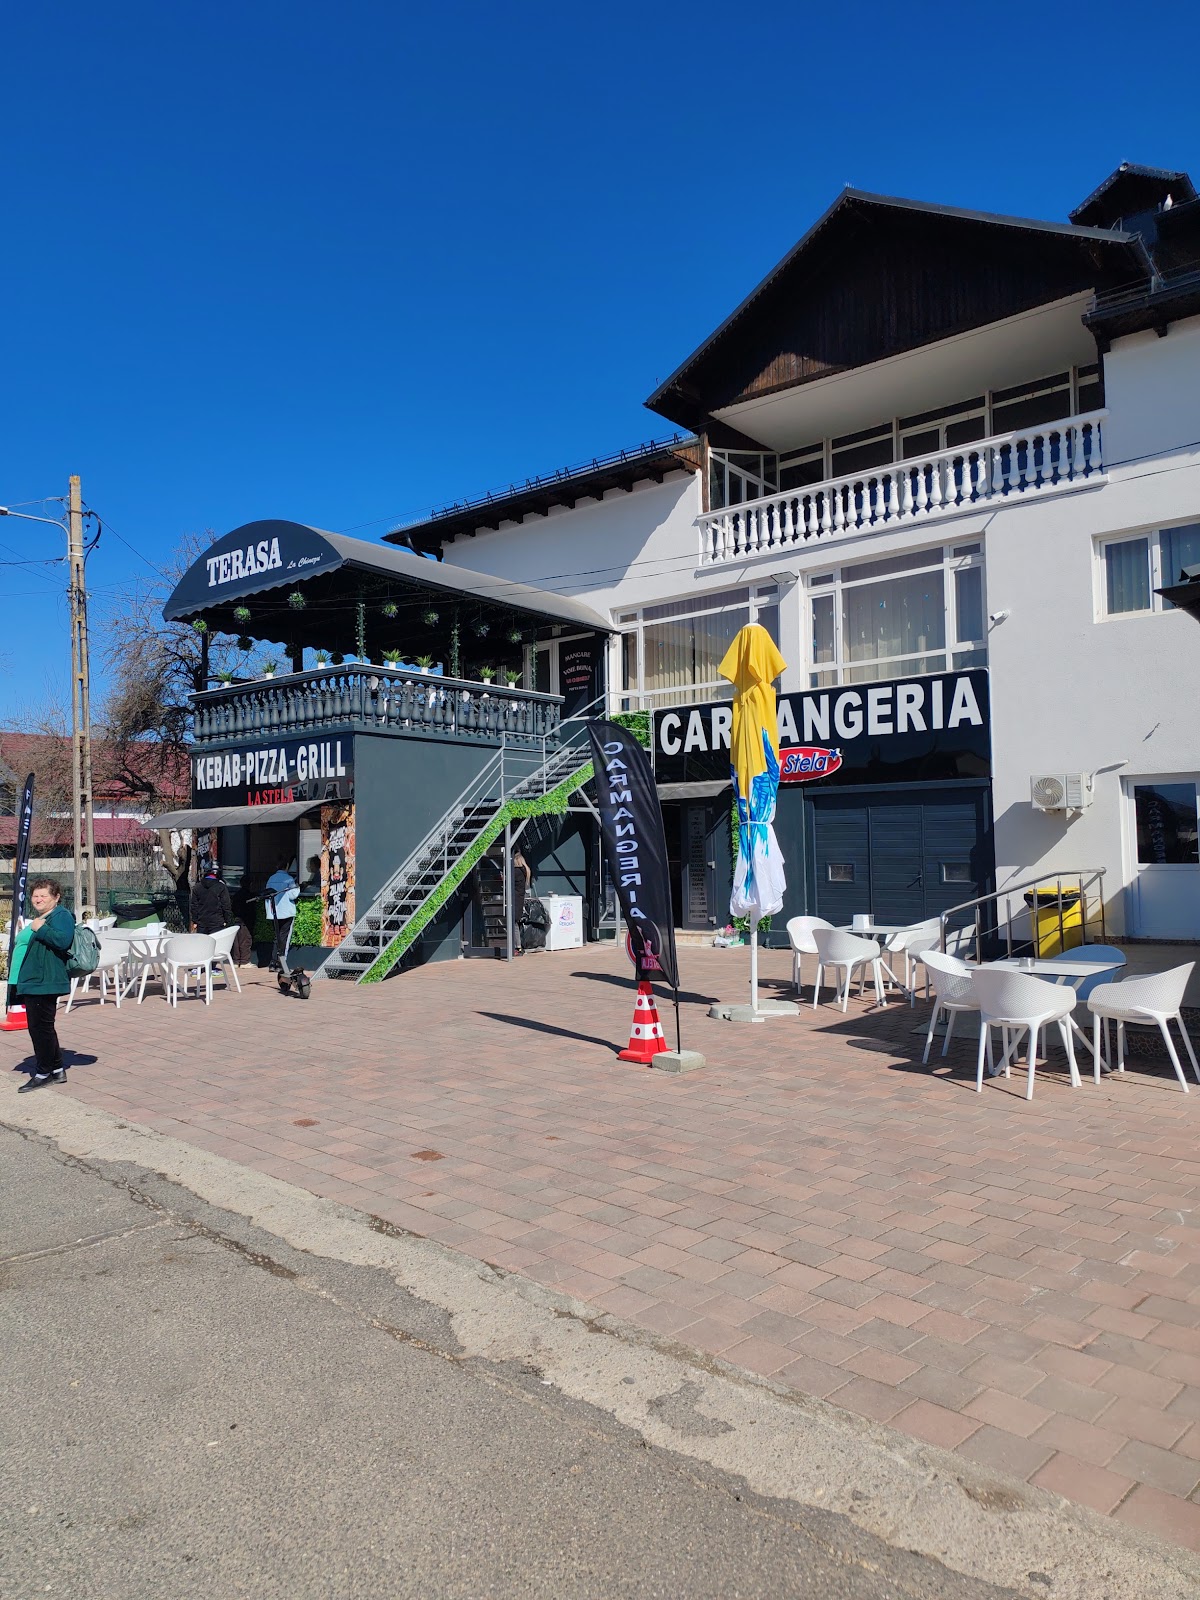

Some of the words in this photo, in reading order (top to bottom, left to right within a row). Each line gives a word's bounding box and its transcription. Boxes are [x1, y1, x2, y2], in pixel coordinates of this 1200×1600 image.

[206, 536, 283, 588] TERASA
[659, 676, 984, 756] CARANGERIA
[783, 752, 829, 774] Stela
[247, 791, 261, 806] LA
[262, 788, 295, 804] STELA
